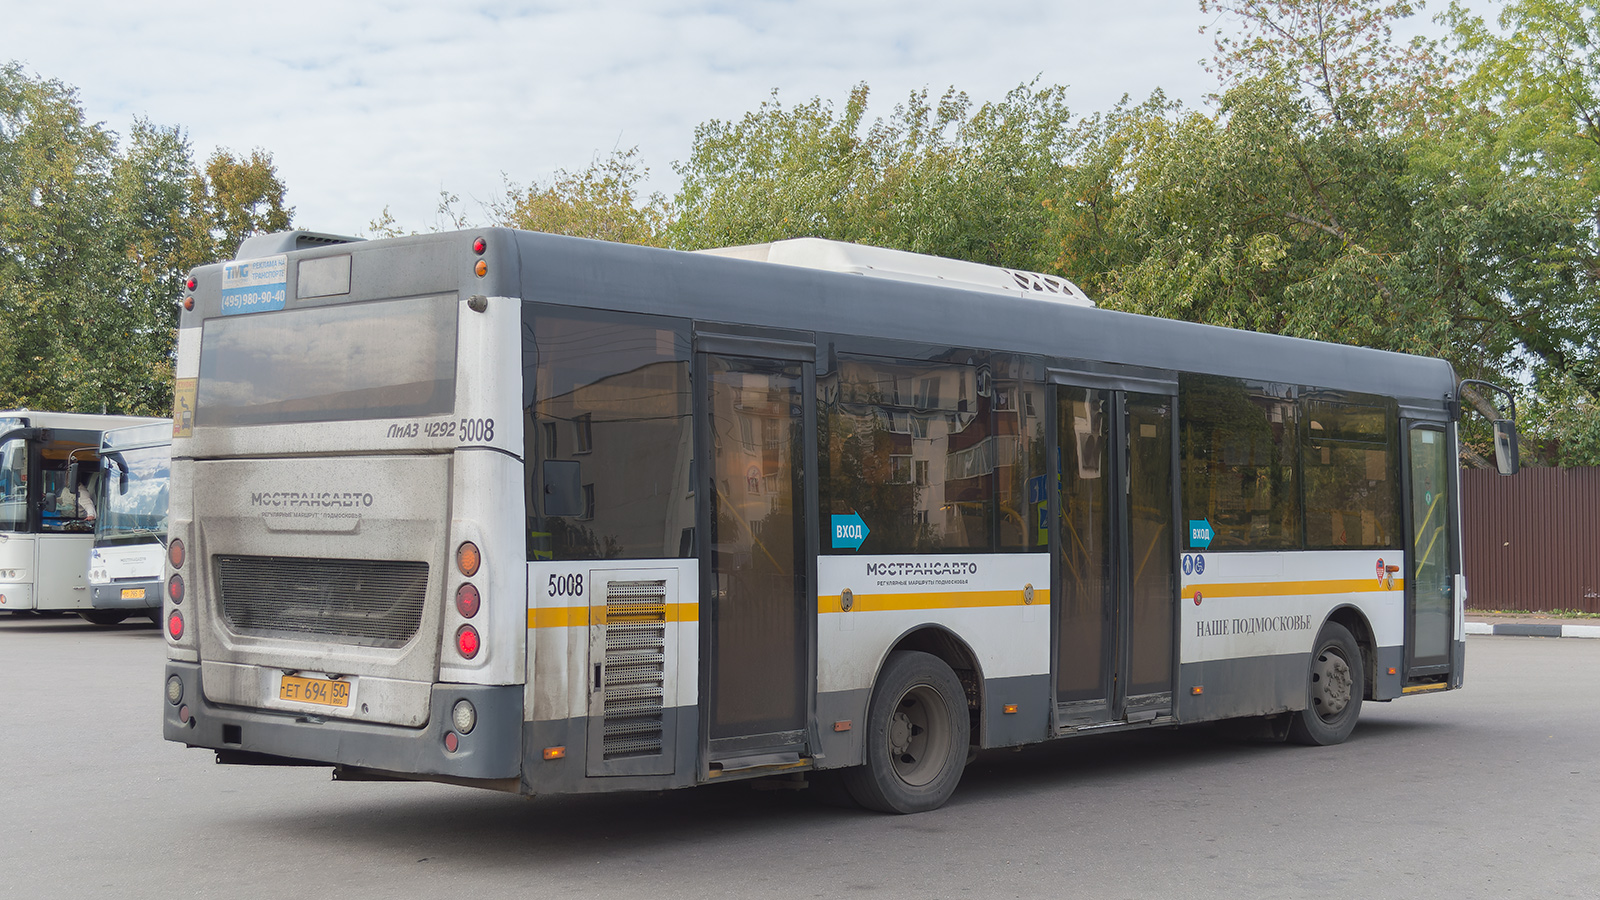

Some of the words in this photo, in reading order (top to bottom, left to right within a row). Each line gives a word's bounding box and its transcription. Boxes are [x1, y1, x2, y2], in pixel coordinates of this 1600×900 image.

[225, 264, 249, 279] TMG
[252, 260, 278, 270] РЕКЛАМА
[252, 269, 286, 280] ТРАНСПОРТЕ
[423, 421, 457, 438] 4292
[459, 418, 495, 442] 5008
[251, 492, 374, 507] МОСТРАНСАВТО
[836, 525, 863, 540] ВХОД
[1192, 527, 1211, 541] ВХОД
[866, 562, 978, 576] МОСТРАНСАВТО
[548, 573, 584, 597] 5008
[1196, 618, 1230, 638] НАШЕ
[1232, 614, 1312, 636] ПОДМОСКОВЬЕ
[304, 681, 328, 701] 694
[333, 683, 346, 698] 50
